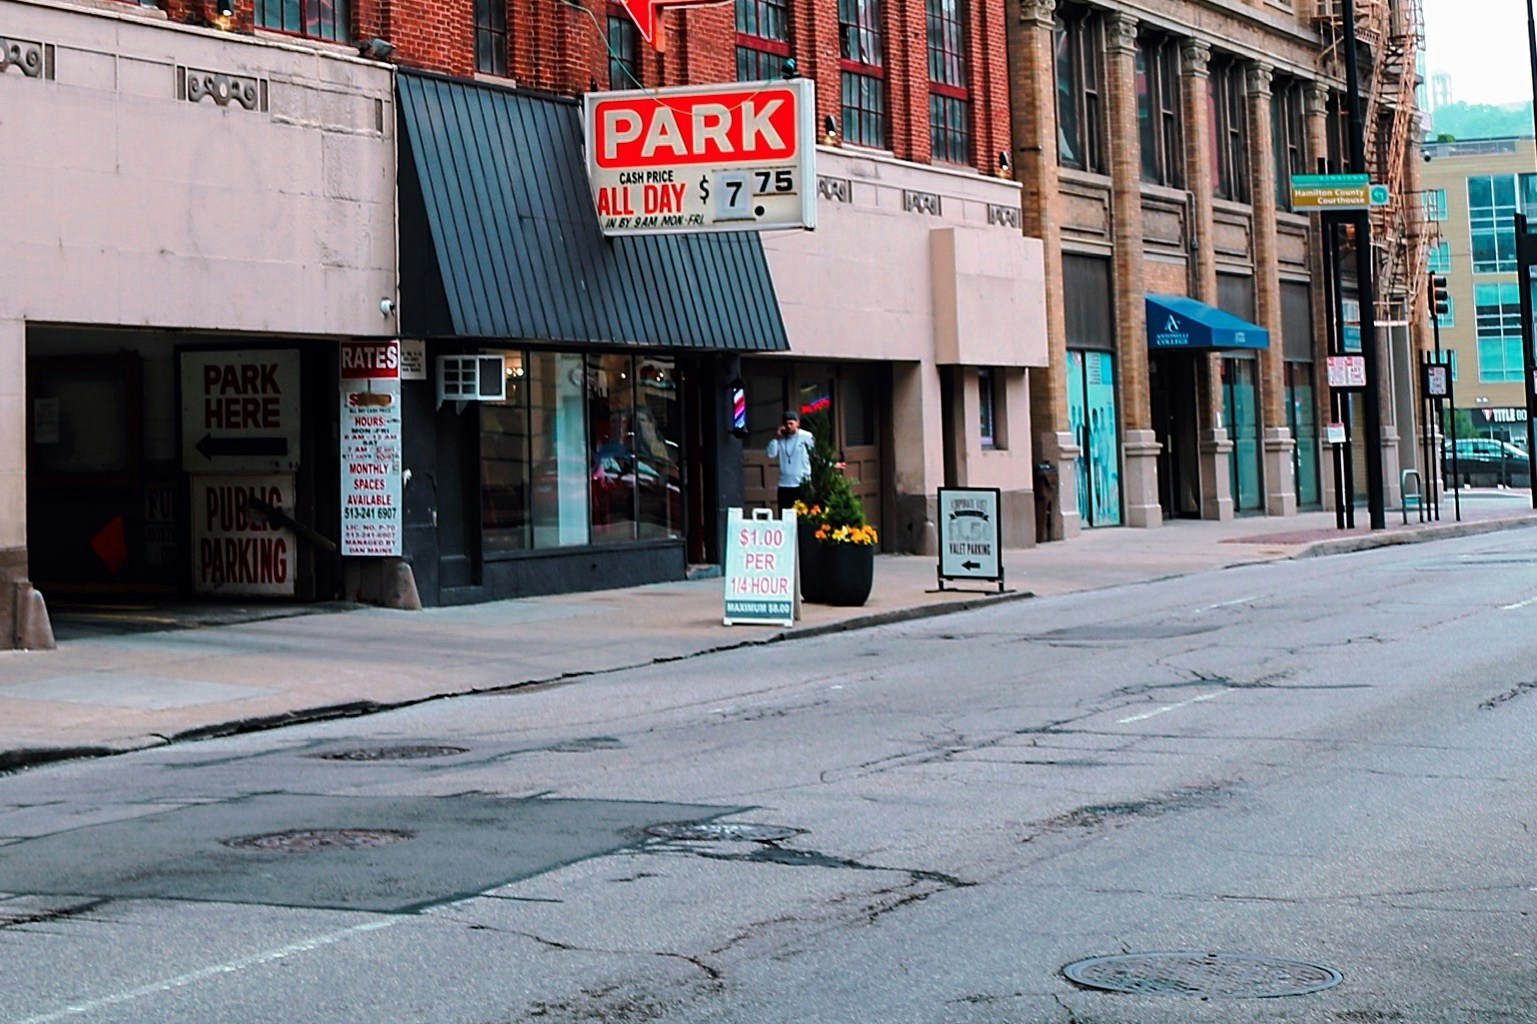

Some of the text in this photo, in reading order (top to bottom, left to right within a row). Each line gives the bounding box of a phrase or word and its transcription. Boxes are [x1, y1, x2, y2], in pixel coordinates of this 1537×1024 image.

[602, 98, 787, 160] PARK
[619, 170, 674, 185] CASH PRICE
[597, 182, 686, 216] ALL DAY
[1295, 188, 1364, 198] Hamilton County
[1317, 196, 1365, 205] Courthouse
[605, 217, 616, 229] IN
[618, 216, 633, 229] BY
[341, 346, 398, 369] RATES
[203, 364, 281, 395] PARK
[205, 397, 281, 429] HERE
[1493, 408, 1516, 422] TITLE
[349, 463, 389, 475] MONTHLY
[353, 478, 385, 490] SPACES
[347, 494, 392, 506] AVAILABLE
[739, 528, 783, 547] $1.00
[949, 543, 991, 555] VALET PARKING
[200, 538, 287, 584] PARKING
[745, 553, 774, 570] PER
[731, 577, 788, 594] 1/4 HOUR
[726, 602, 767, 613] MAXIMUM
